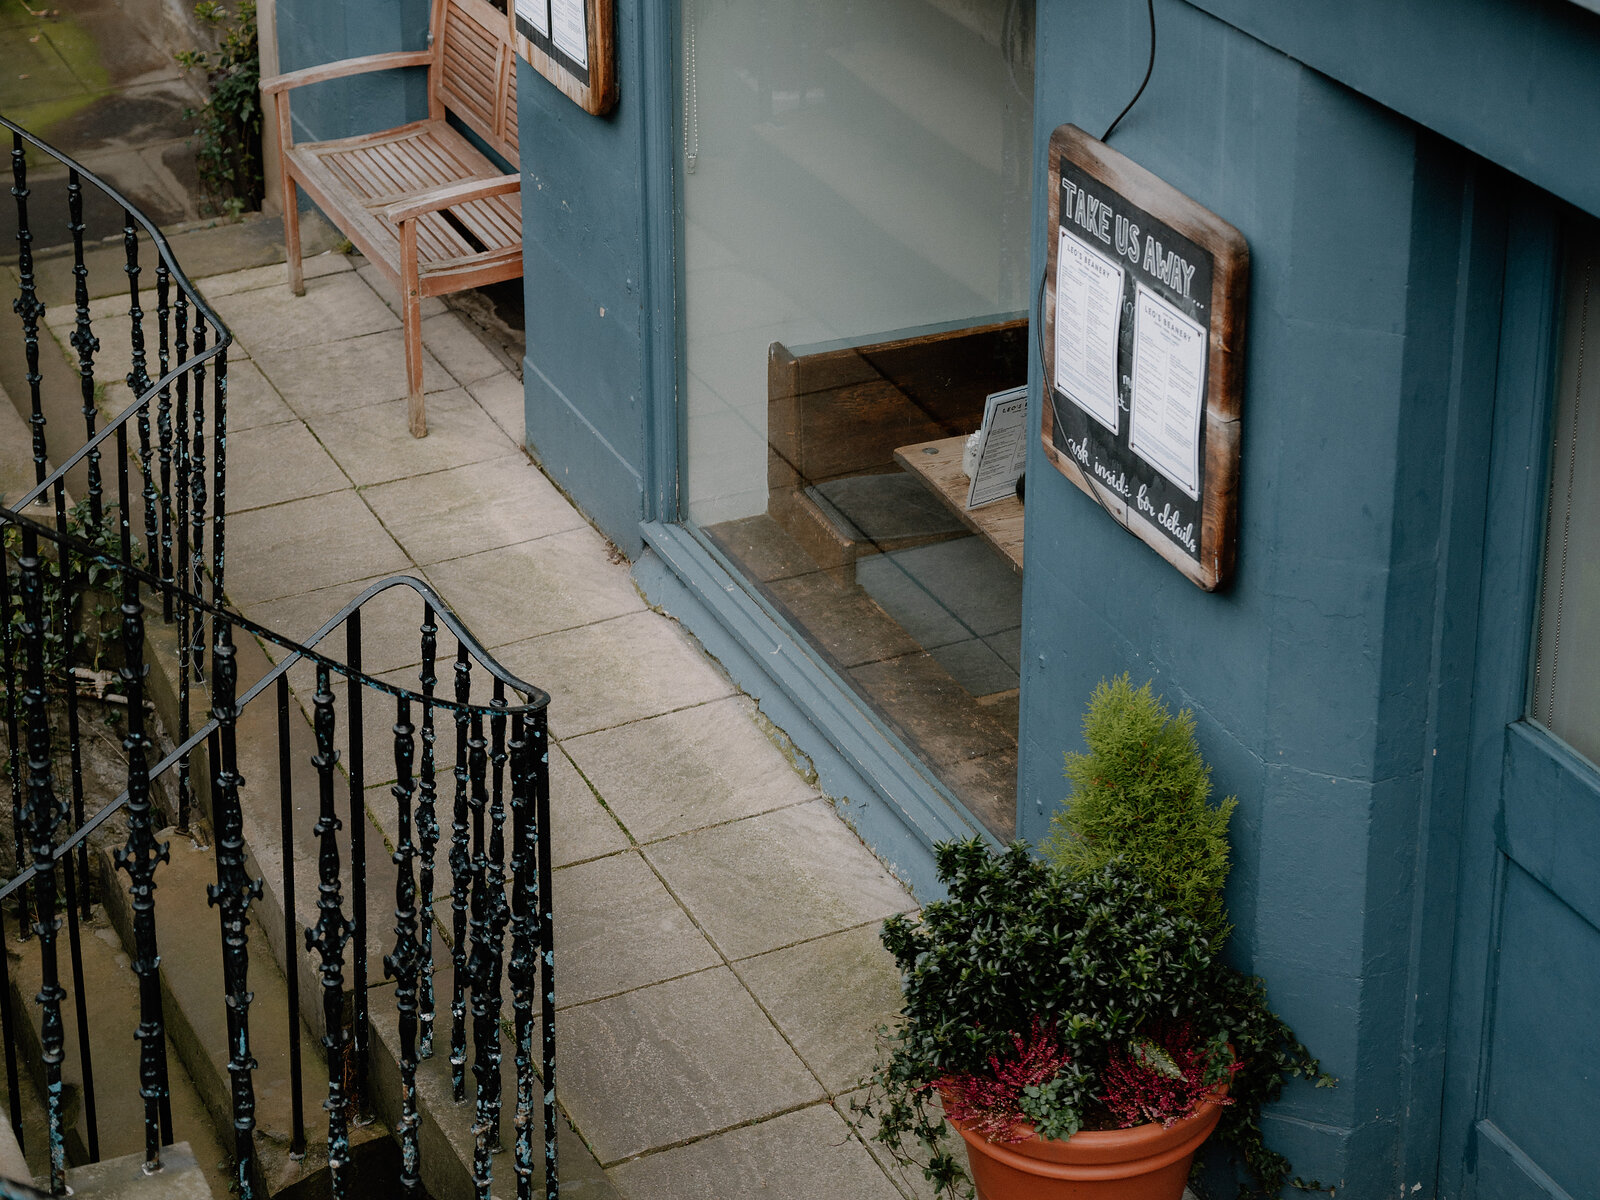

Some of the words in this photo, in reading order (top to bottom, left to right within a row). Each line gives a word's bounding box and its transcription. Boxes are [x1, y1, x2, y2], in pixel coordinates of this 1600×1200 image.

[1062, 177, 1113, 244] TAKE
[1115, 214, 1140, 263] US
[1084, 256, 1110, 278] BEANERY
[1163, 318, 1191, 342] BEANERY
[1136, 484, 1155, 516] for
[1158, 503, 1197, 552] details
